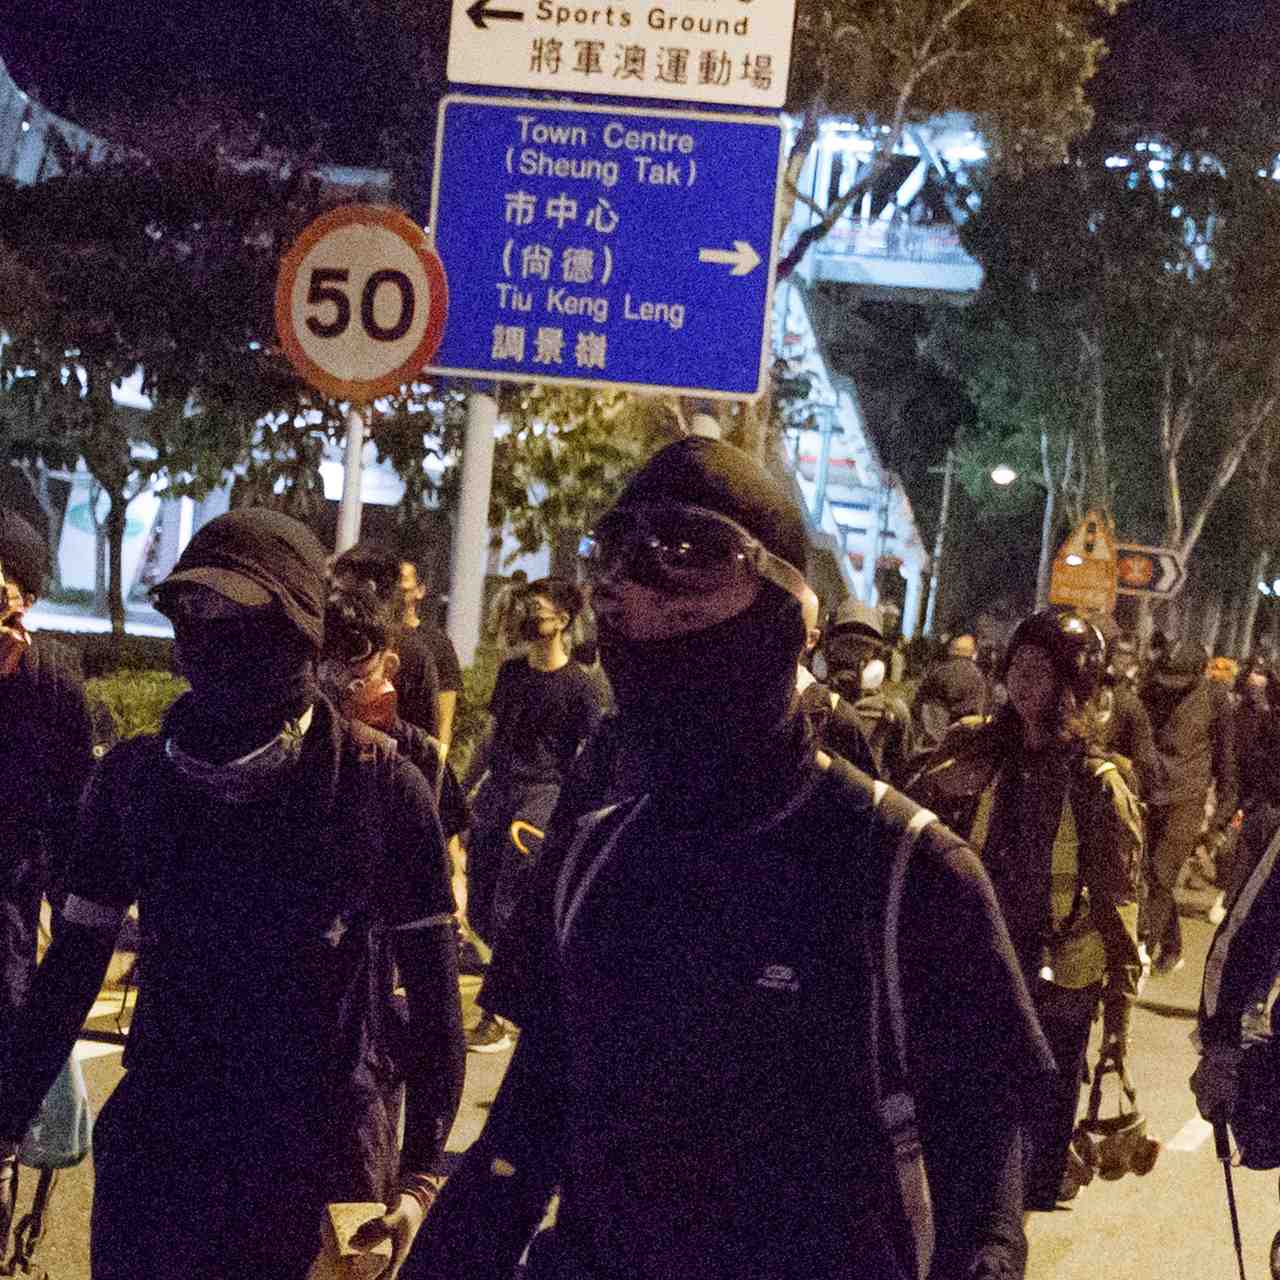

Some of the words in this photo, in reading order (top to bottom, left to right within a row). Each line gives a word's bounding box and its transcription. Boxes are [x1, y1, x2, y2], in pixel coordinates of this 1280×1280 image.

[535, 0, 631, 26] Sports
[648, 8, 750, 36] Ground
[527, 37, 774, 90] 將軍澳運動場
[517, 115, 587, 146] Town
[602, 121, 694, 153] Centre
[504, 190, 620, 235] 市中心
[305, 267, 416, 342] 50
[496, 282, 533, 311] Tiu
[546, 287, 609, 323] Keng
[624, 293, 685, 330] Leng
